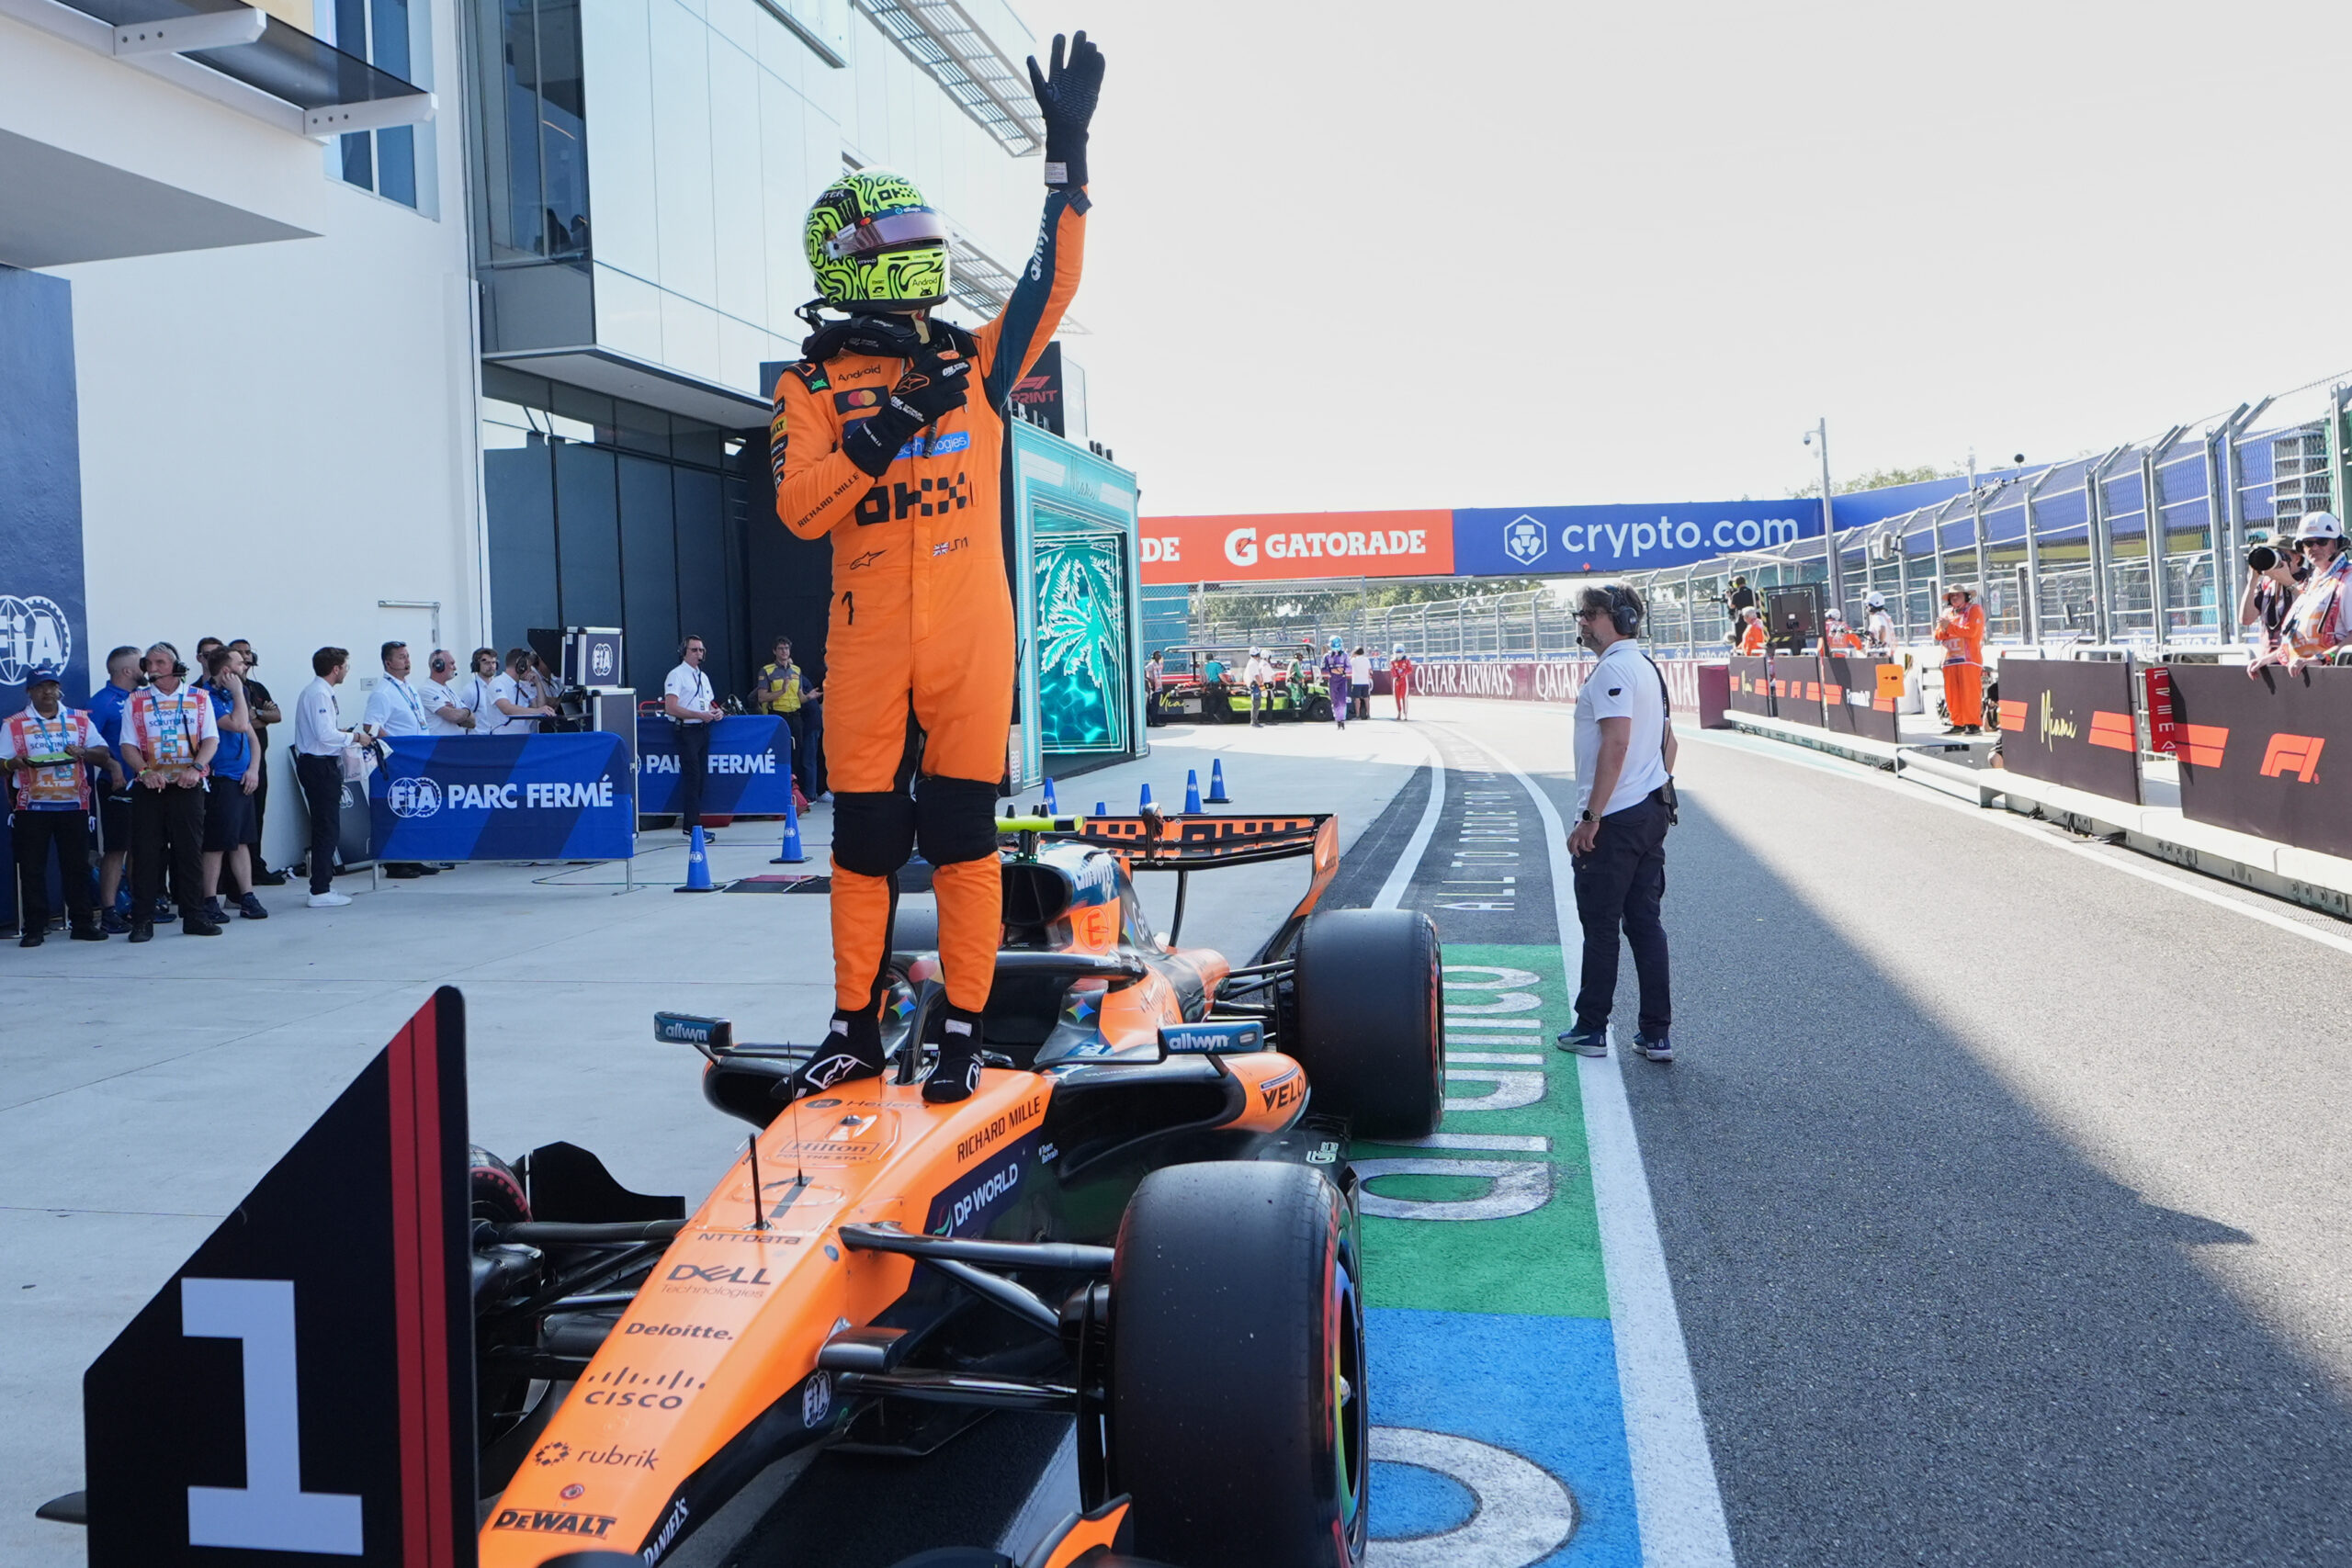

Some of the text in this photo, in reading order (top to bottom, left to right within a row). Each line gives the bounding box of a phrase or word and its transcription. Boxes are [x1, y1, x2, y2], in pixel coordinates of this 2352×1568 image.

[911, 276, 938, 287] Android
[838, 364, 881, 383] Android
[1011, 390, 1059, 404] PRINT
[797, 471, 860, 528] RICHARD MILLE
[1136, 536, 1182, 562] DE
[1264, 530, 1427, 559] GATORADE
[1562, 516, 1799, 558] crypto.com
[1414, 664, 1513, 696] QATAR AIRWAYS
[1535, 664, 1580, 701] QATAR
[2041, 689, 2077, 752] Miami
[707, 748, 775, 774] FERMÉ
[2259, 732, 2325, 784] F1
[447, 783, 517, 809] PARC
[526, 773, 613, 808] FERMÉ
[1432, 876, 1516, 911] ALL
[664, 1021, 707, 1043] allwyn
[1169, 1032, 1230, 1052] allwyn
[1261, 1075, 1306, 1112] VELO
[956, 1096, 1041, 1164] RICHARD MILLE
[792, 1142, 868, 1154] Hilton
[762, 1176, 815, 1219] 1
[954, 1162, 1019, 1228] DP WORLD
[666, 1264, 772, 1285] DELL
[661, 1283, 766, 1299] Technologies
[625, 1322, 734, 1341] Deloitte.
[584, 1390, 684, 1410] CISCO
[181, 1277, 364, 1555] 1
[577, 1444, 661, 1472] rubrik
[641, 1496, 690, 1568] DANIEL'S
